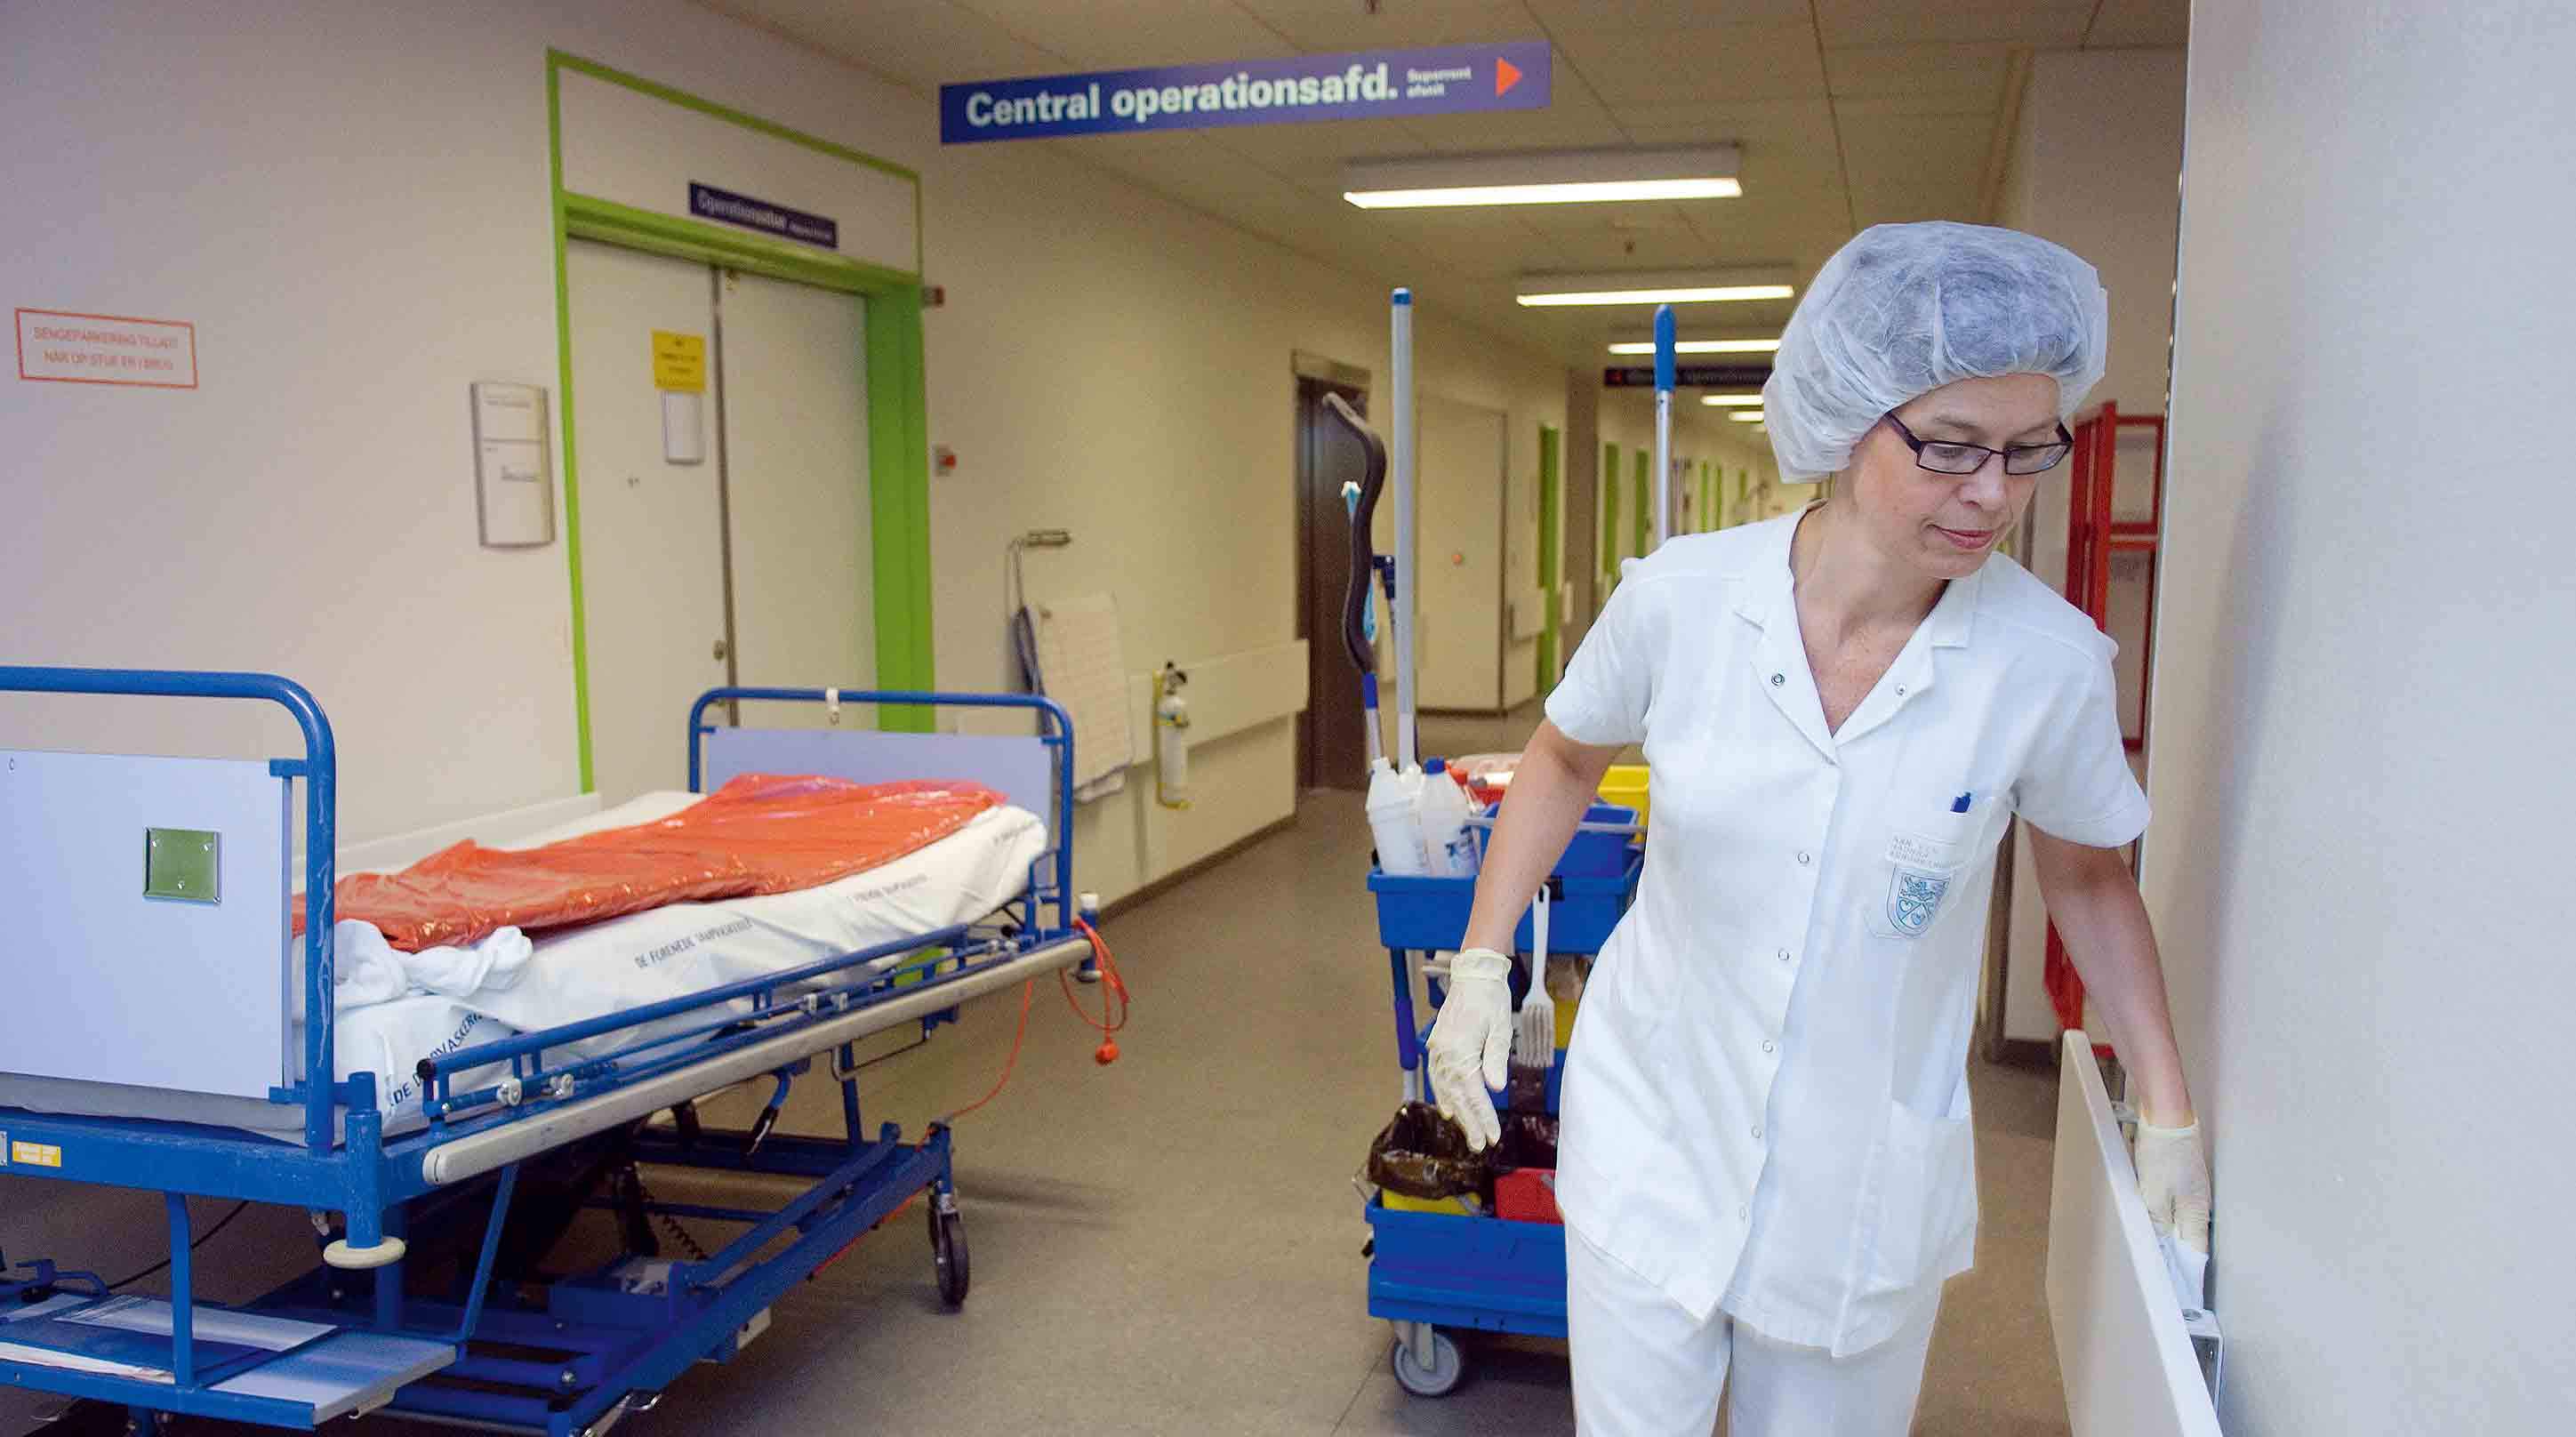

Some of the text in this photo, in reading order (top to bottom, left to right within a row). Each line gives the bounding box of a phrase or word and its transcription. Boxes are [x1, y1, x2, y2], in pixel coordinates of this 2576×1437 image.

[966, 62, 1399, 127] Central operationsafd.
[634, 955, 649, 968] DE
